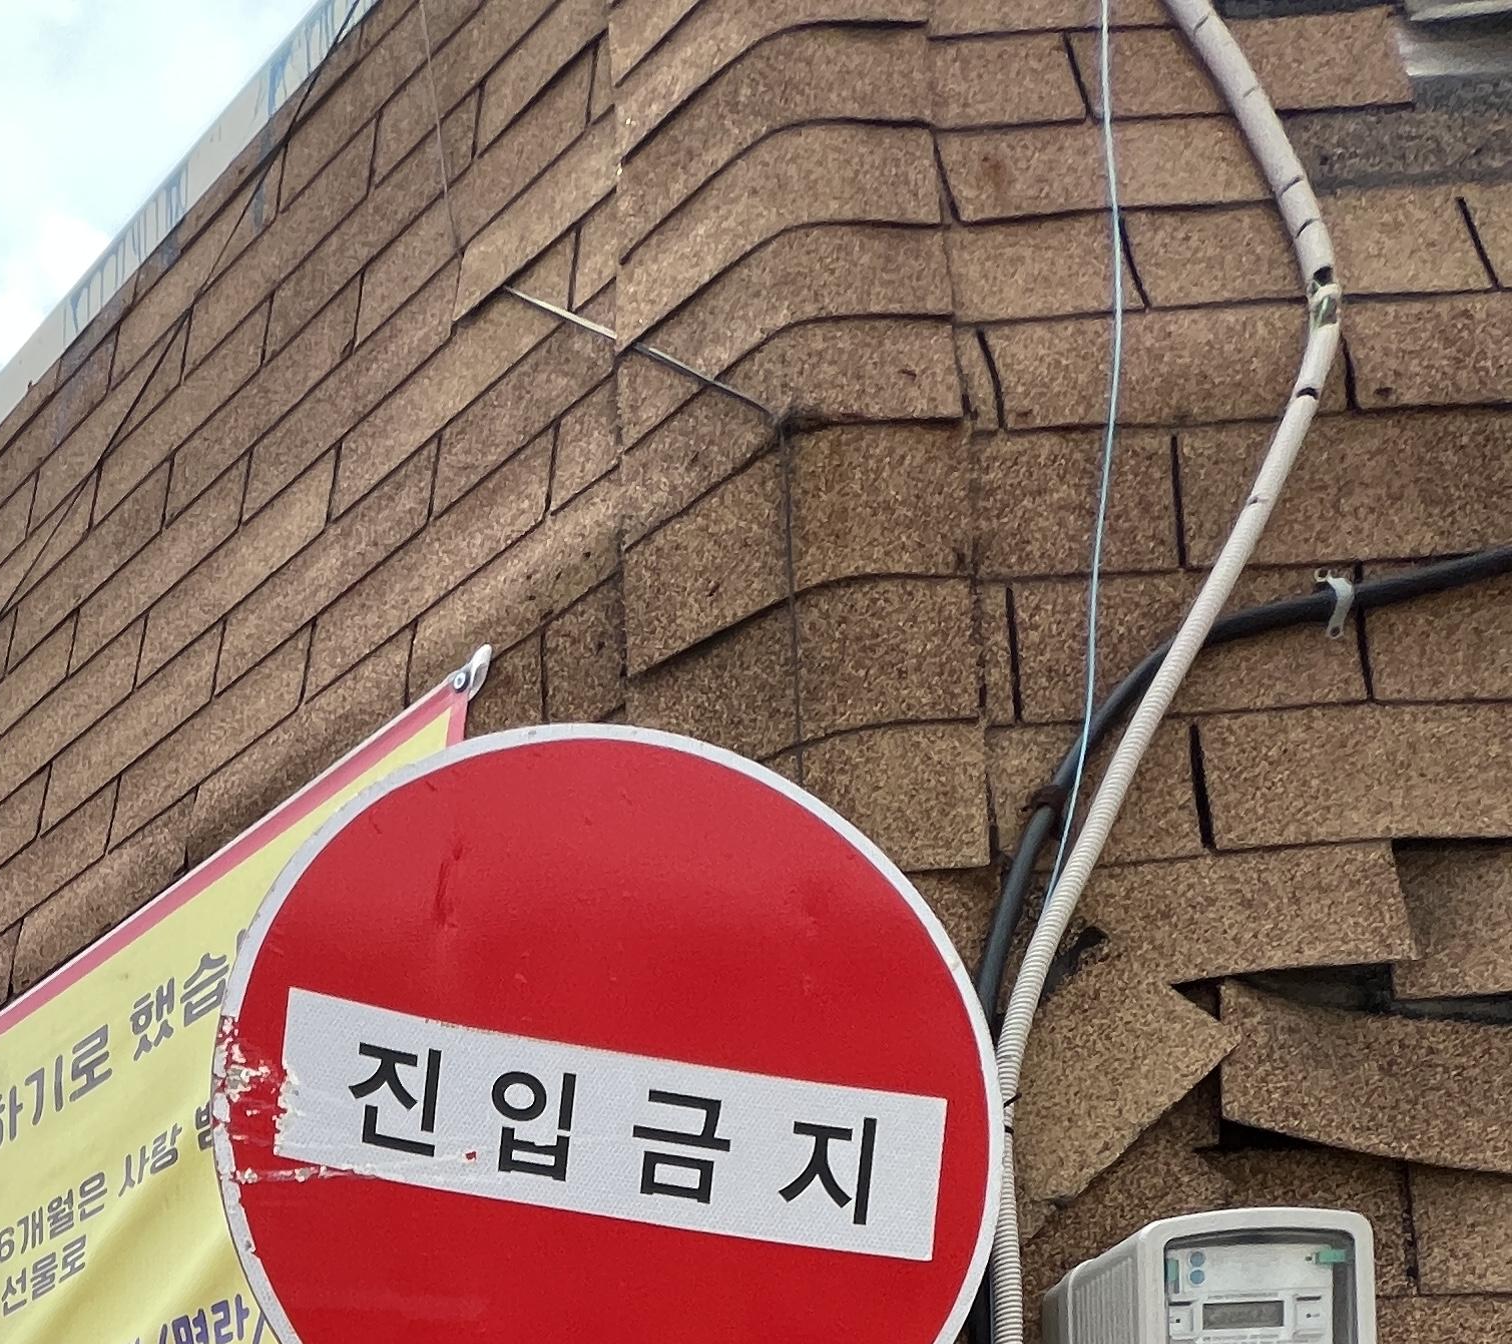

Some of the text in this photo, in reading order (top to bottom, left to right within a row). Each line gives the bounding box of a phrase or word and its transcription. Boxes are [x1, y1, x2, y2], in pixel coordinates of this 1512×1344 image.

[129, 929, 246, 1061] 했습
[118, 1123, 182, 1198] 사랑
[349, 1042, 879, 1225] 진입금지
[2, 1234, 87, 1319] 선물로
